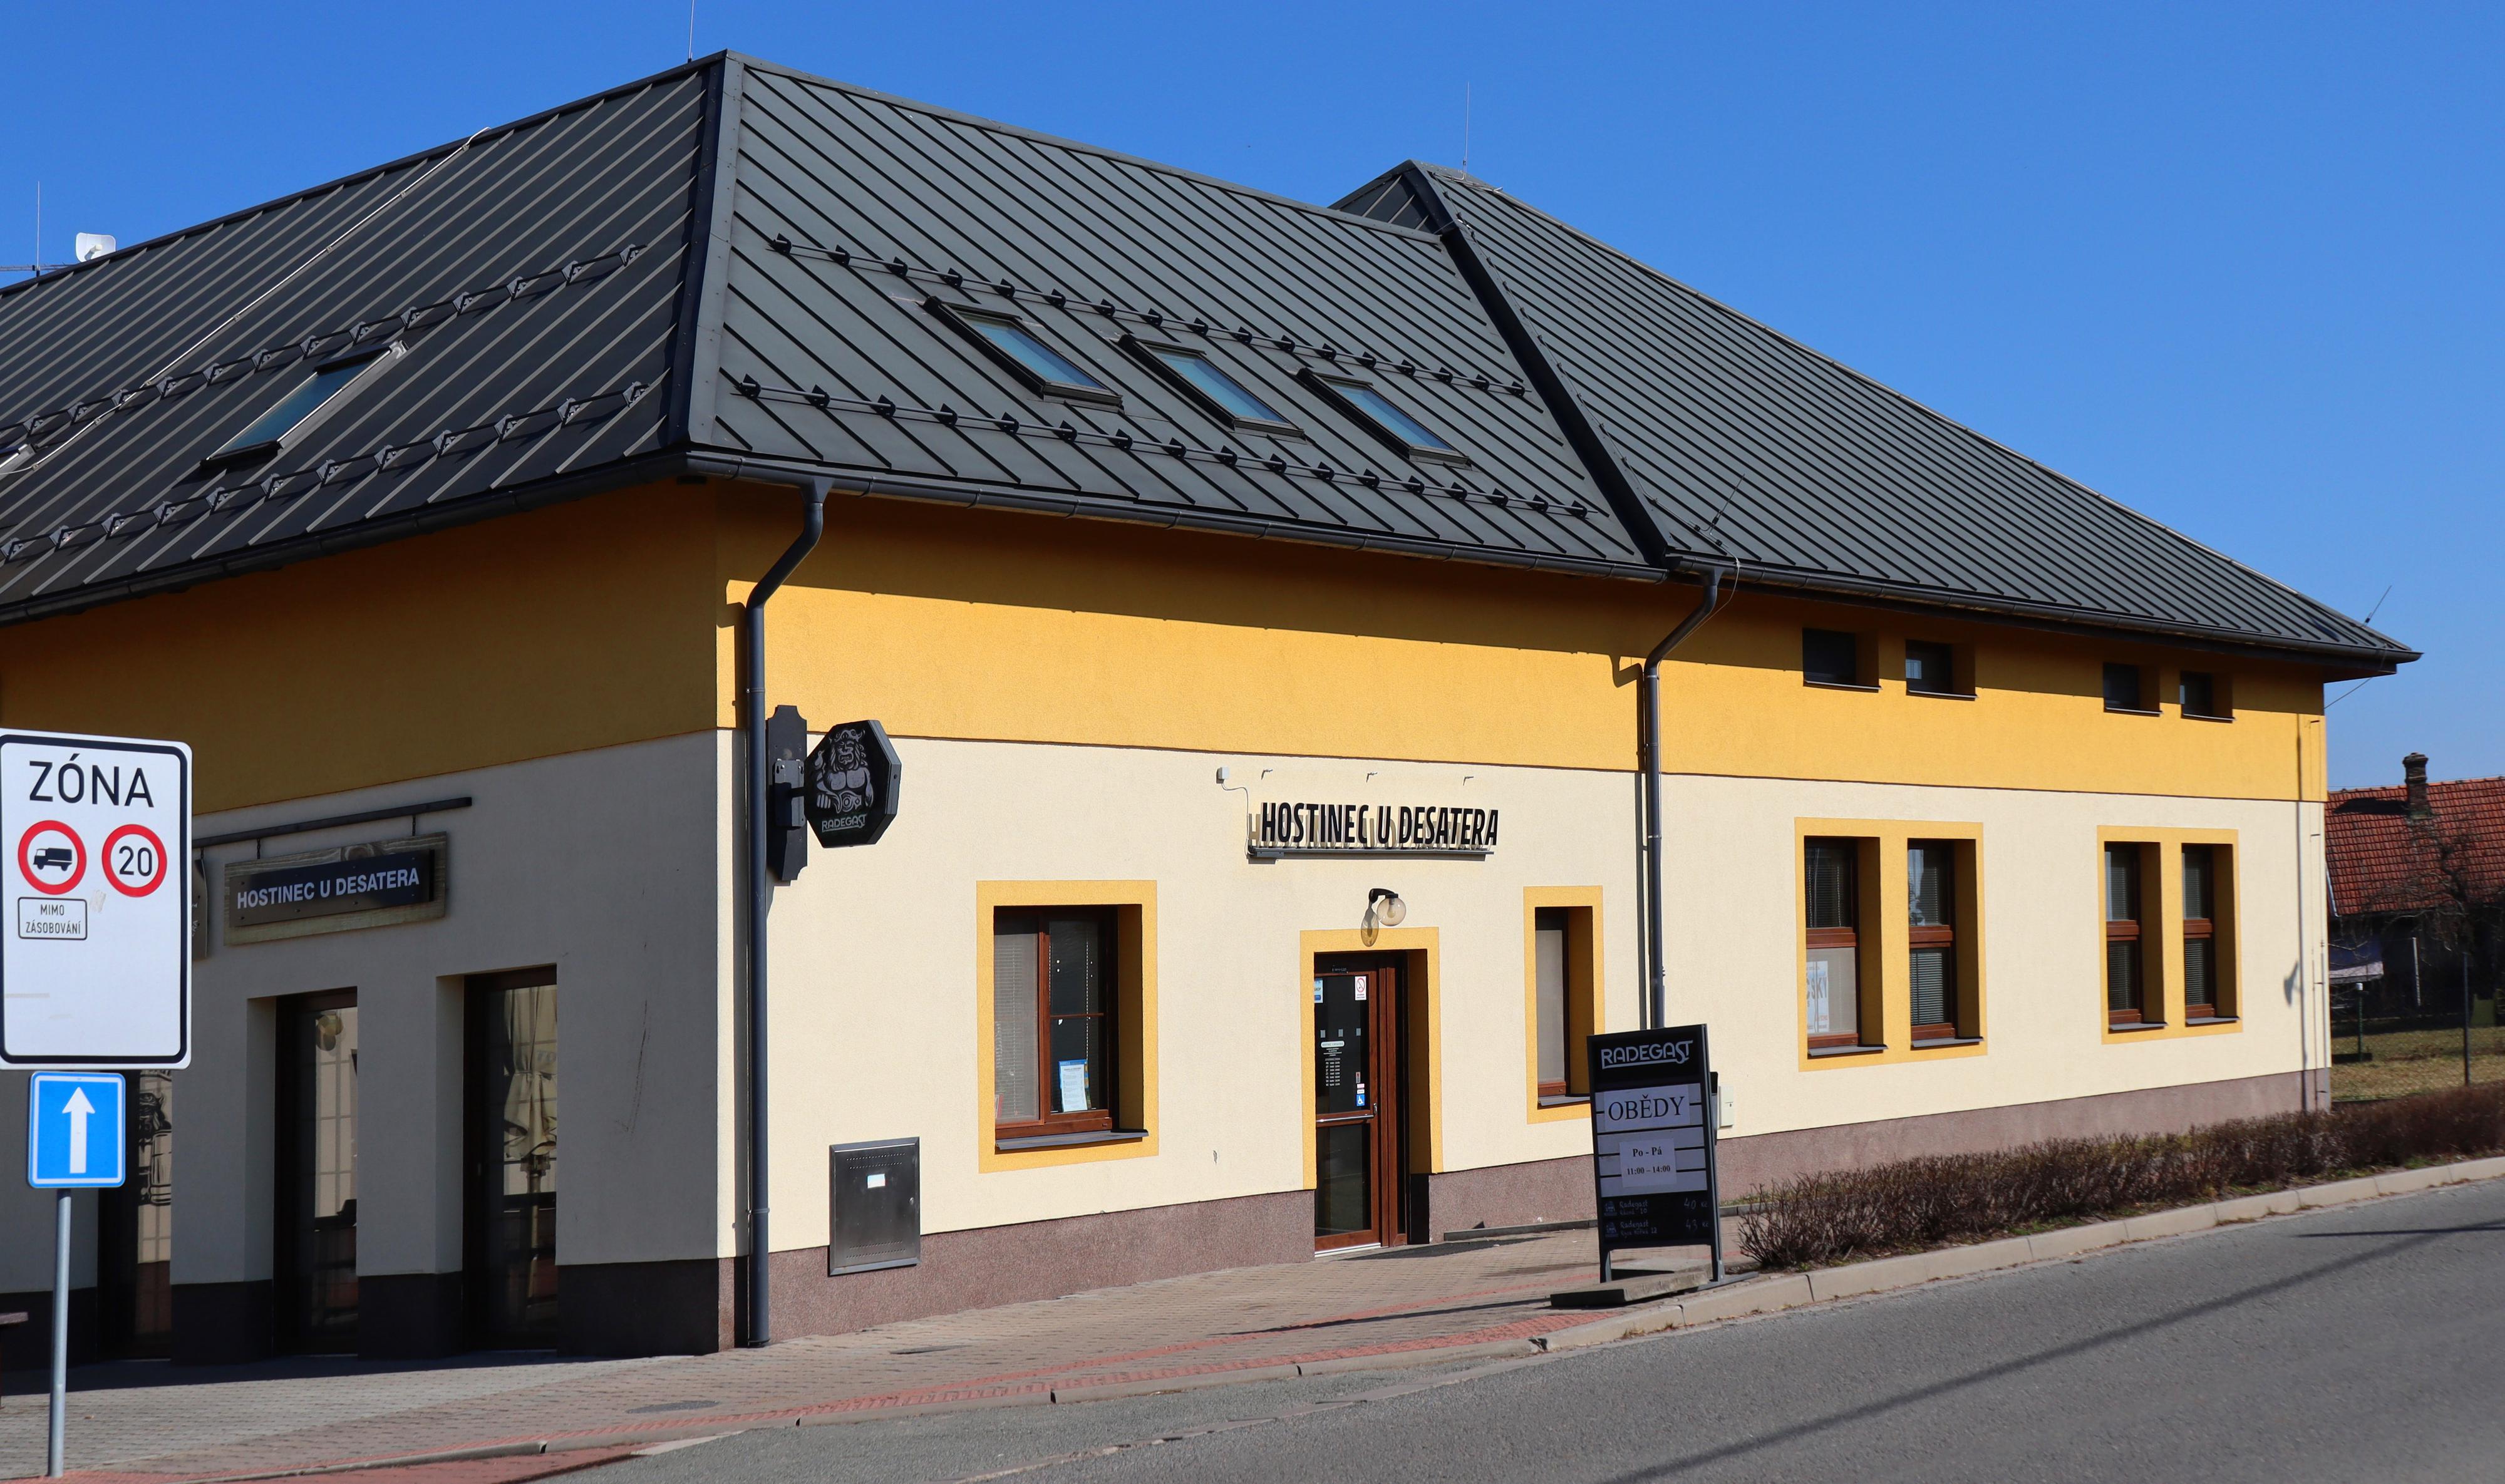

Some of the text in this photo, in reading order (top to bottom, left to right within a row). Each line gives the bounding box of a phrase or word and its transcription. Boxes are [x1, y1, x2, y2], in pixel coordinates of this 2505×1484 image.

[29, 754, 154, 808] ZÓNA
[822, 813, 867, 833] RADEGAST
[1261, 802, 1499, 845] HOSTINEC U DESATERA
[118, 845, 153, 877] 20
[237, 867, 420, 910] HOSTINEC U DESATERA
[40, 904, 65, 917] MIMO
[26, 919, 81, 935] ZÁSOBOVÁNÍ
[1601, 1040, 1693, 1069] RADEGAST
[1608, 1094, 1685, 1121] OBĚDY
[1632, 1148, 1643, 1157] Po
[1651, 1146, 1663, 1156] Pá
[1626, 1167, 1645, 1175] 11:00
[1652, 1165, 1671, 1174] 14:00
[1619, 1199, 1648, 1210] Radegast
[1619, 1219, 1649, 1229] Radegast
